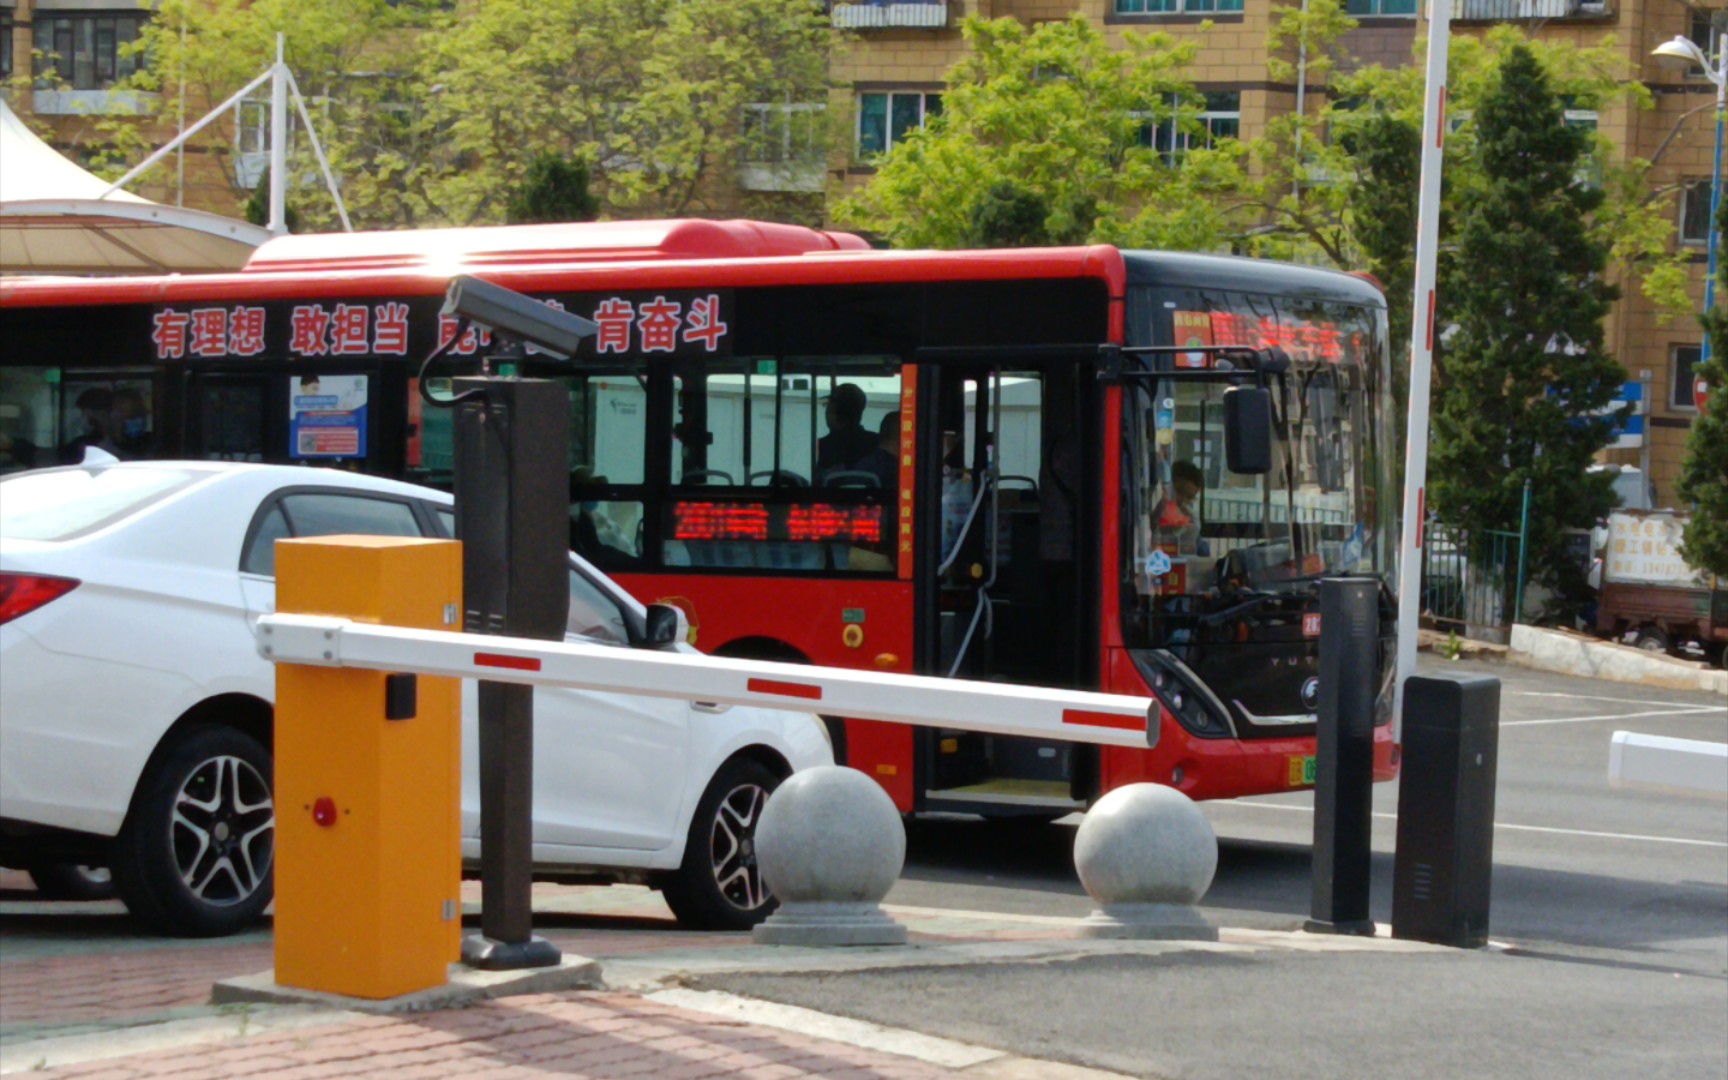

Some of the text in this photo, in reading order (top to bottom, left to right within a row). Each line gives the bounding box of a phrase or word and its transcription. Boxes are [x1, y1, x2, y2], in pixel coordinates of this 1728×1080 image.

[152, 306, 266, 359] 有理想
[290, 301, 410, 355] 敢担当
[593, 293, 727, 353] 肯奋斗
[1271, 656, 1313, 666] YUT
